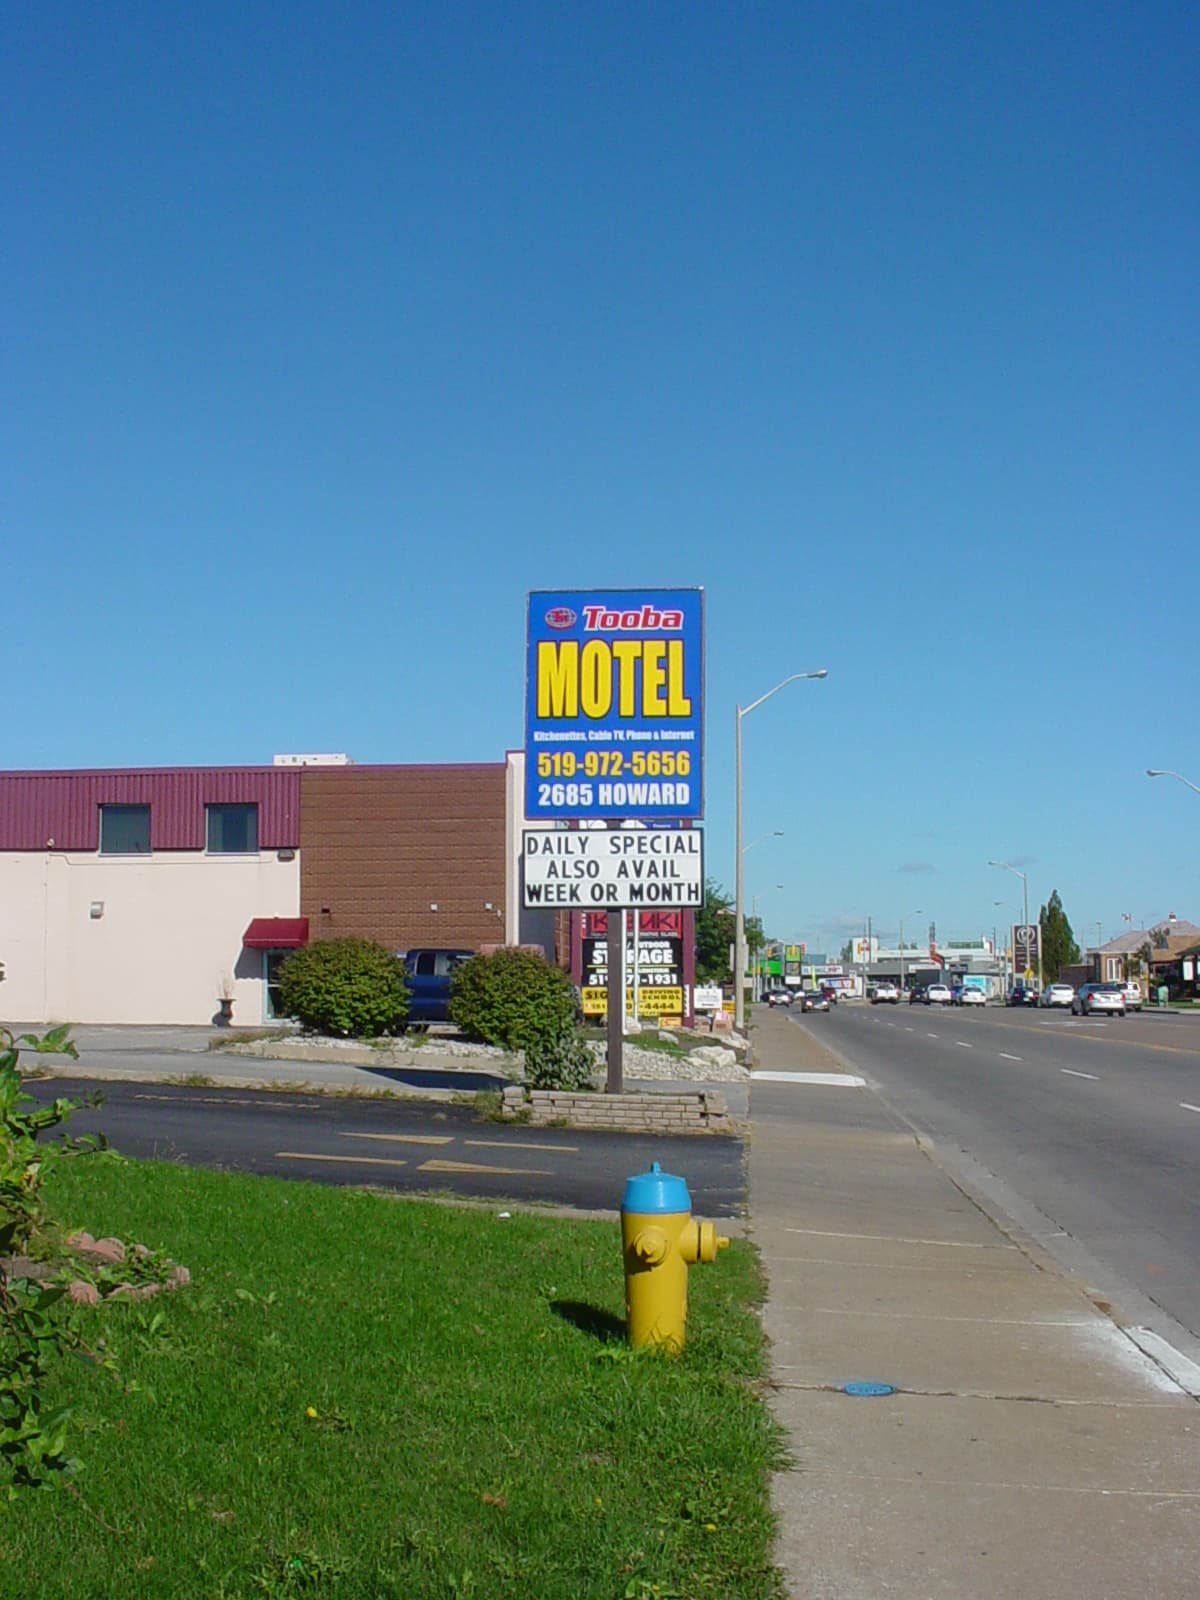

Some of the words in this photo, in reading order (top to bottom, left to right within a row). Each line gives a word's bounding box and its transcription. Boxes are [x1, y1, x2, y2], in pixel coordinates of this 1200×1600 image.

[582, 605, 684, 631] Tooba
[537, 640, 692, 718] MOTEL
[588, 730, 612, 741] Cable
[626, 730, 652, 740] Phone
[660, 730, 694, 740] Internet
[537, 751, 690, 777] 519-972-5656
[538, 784, 593, 806] 2685
[598, 783, 690, 806] HOWARD
[527, 836, 589, 855] DAILY
[610, 835, 699, 854] SPECIAL
[547, 860, 600, 879] ALSO
[616, 859, 681, 878] AVAIL
[526, 884, 582, 902] WEEK
[590, 883, 618, 902] OR
[629, 883, 700, 901] MONTH
[592, 949, 673, 964] STRAGE
